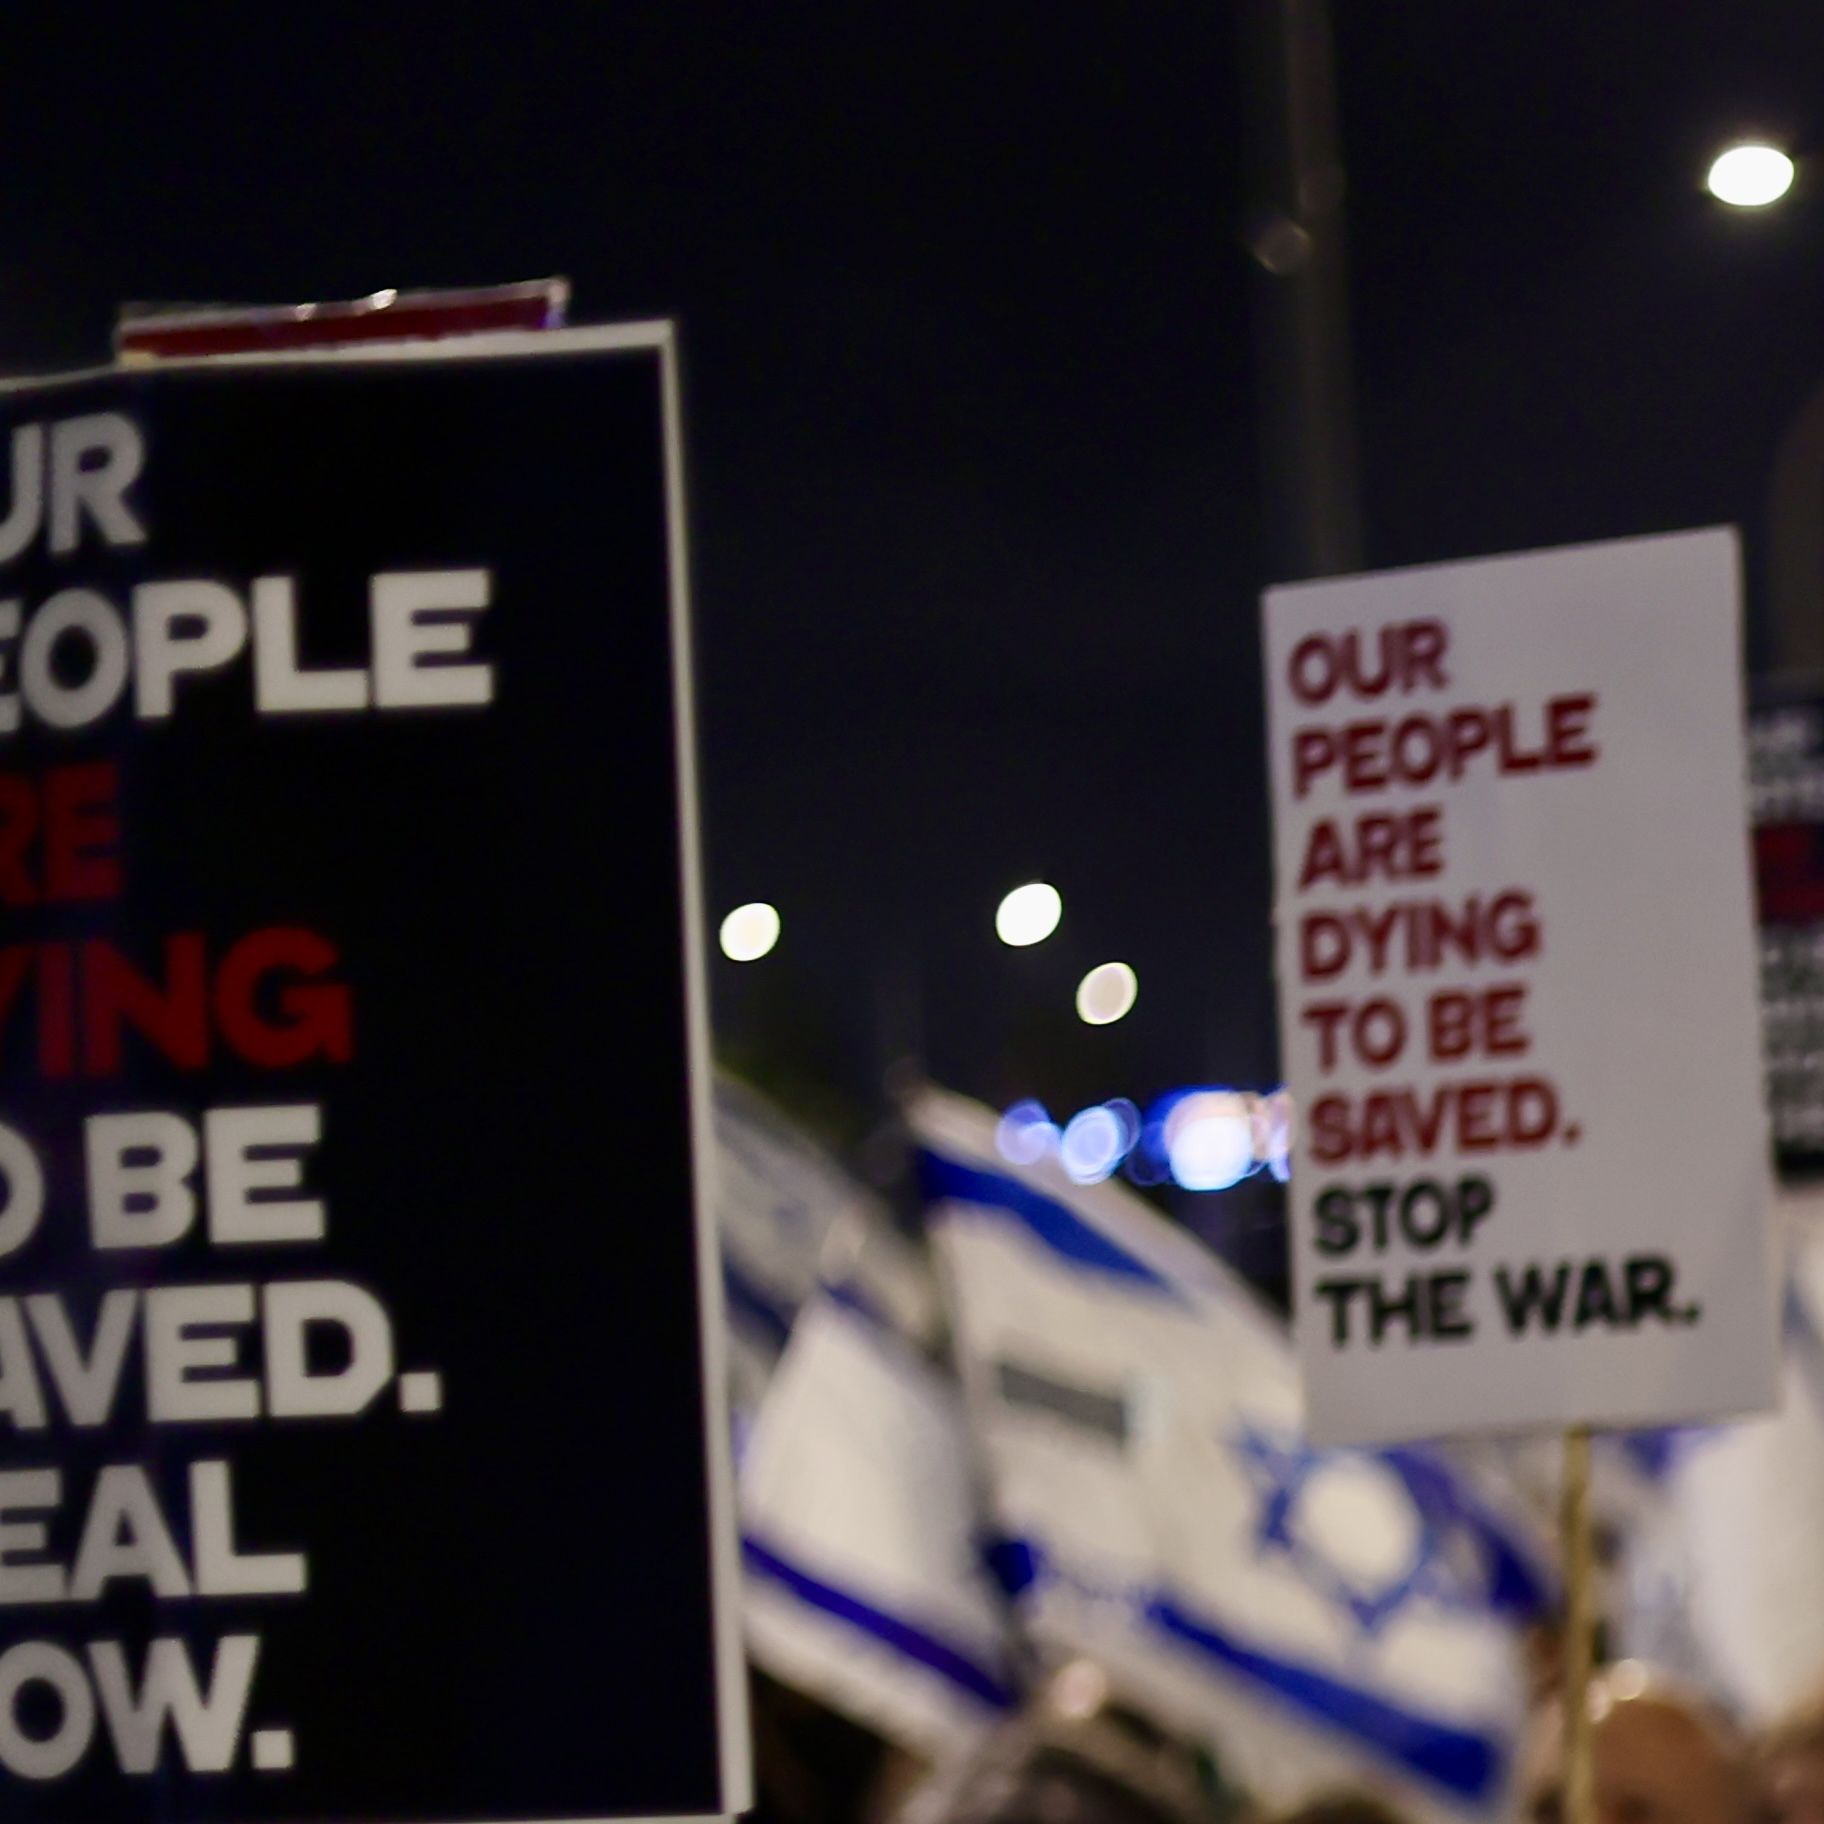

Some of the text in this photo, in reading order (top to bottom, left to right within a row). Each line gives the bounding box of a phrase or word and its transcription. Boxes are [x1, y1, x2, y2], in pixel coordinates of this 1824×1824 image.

[0, 568, 494, 736] OPLE
[1287, 619, 1449, 708] OUR
[1292, 693, 1598, 800] PEOPLE
[1298, 805, 1444, 891] ARE
[1299, 890, 1541, 984] DYING
[1301, 983, 1530, 1073] TO BE
[1309, 1076, 1582, 1168] SAVED.
[84, 1101, 327, 1250] BE
[1313, 1174, 1495, 1258] STOP
[1314, 1254, 1702, 1347] THE WAR.
